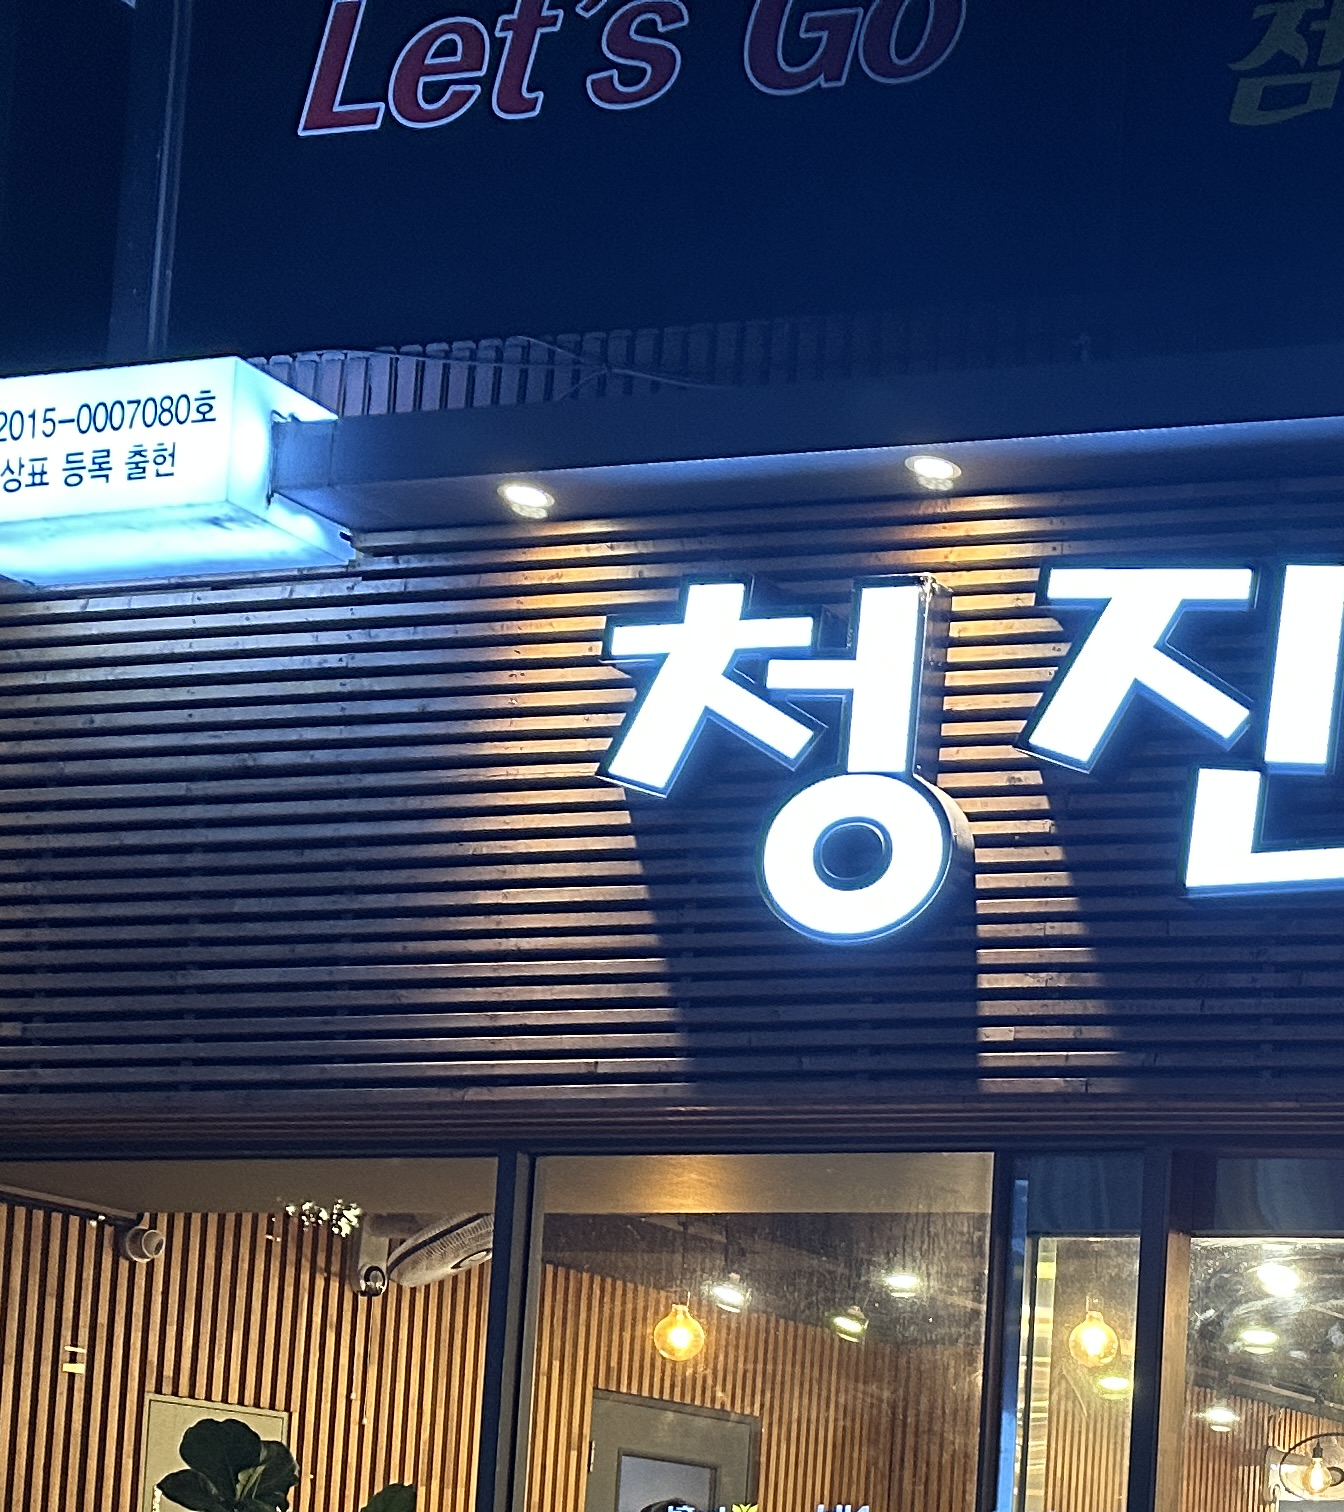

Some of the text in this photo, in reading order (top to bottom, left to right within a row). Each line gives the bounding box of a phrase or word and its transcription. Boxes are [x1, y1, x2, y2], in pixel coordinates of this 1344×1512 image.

[298, 0, 966, 136] Let's Go
[0, 456, 49, 493] 상표
[62, 448, 113, 487] 등록
